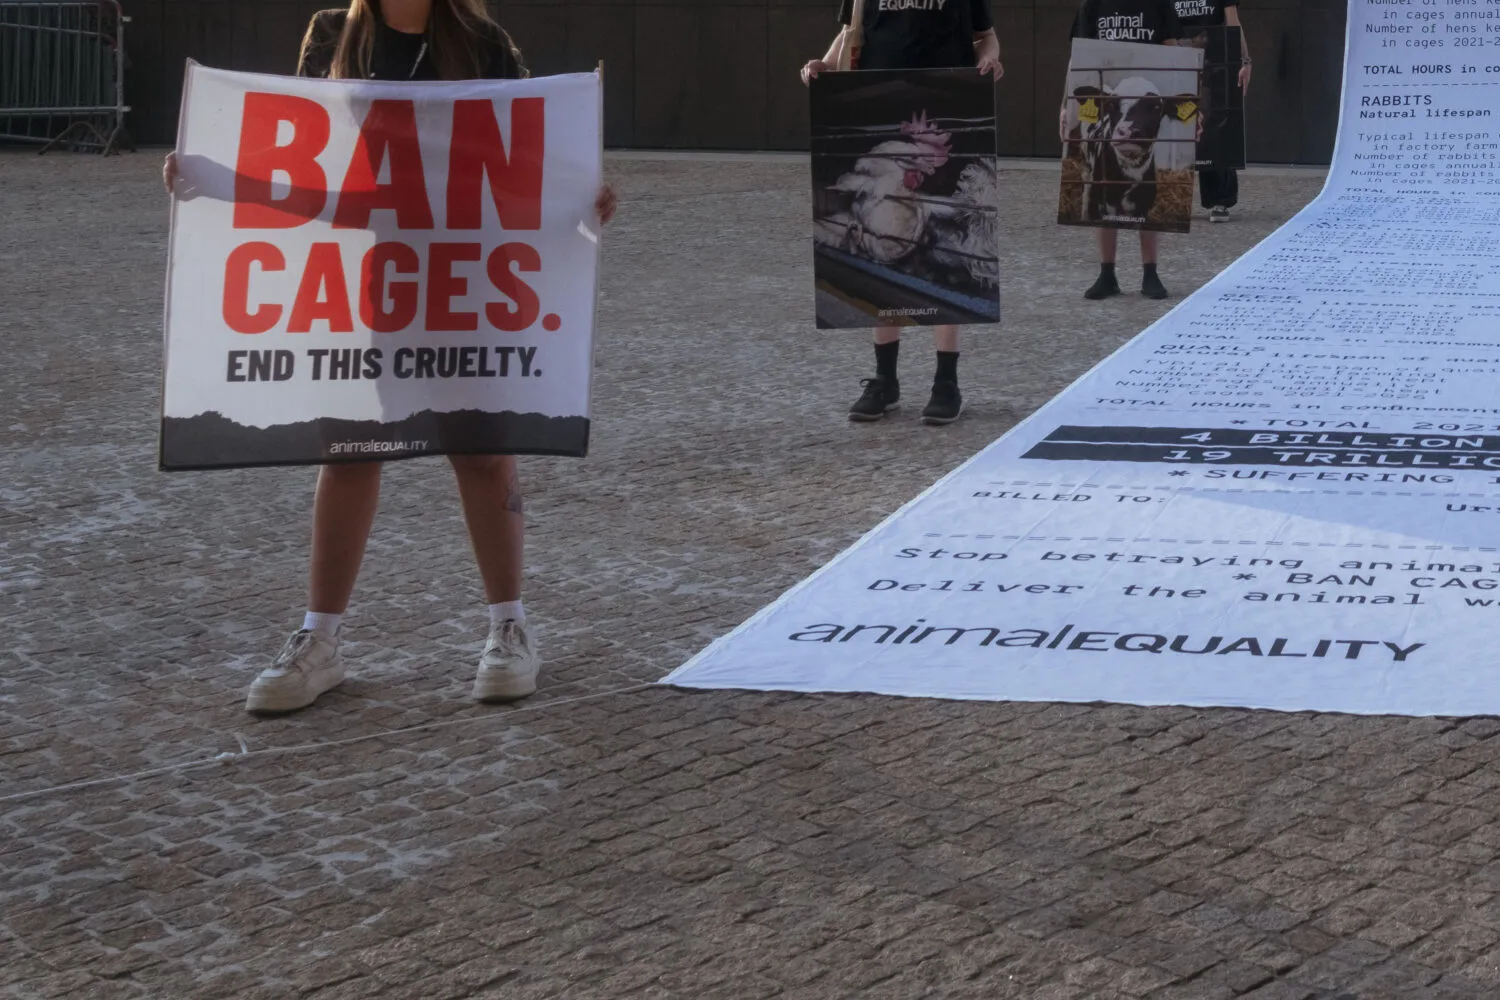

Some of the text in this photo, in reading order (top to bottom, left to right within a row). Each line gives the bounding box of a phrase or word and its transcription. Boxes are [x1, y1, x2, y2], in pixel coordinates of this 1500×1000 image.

[1099, 12, 1143, 28] animal
[1382, 8, 1401, 20] in
[1406, 11, 1445, 22] cages
[1099, 29, 1155, 40] EQUALITY
[1365, 23, 1414, 34] Number
[1421, 23, 1437, 34] of
[1445, 23, 1477, 34] hens
[1381, 39, 1397, 48] in
[1405, 39, 1444, 50] cages
[1363, 64, 1403, 75] TOTAL
[1411, 64, 1452, 74] HOURS
[1460, 62, 1478, 75] in
[1361, 94, 1432, 107] RABBITS
[233, 91, 544, 231] BAN
[222, 241, 562, 334] CAGES.
[226, 347, 543, 382] END THIS CRUELTY.
[1263, 419, 1382, 430] TOTAL
[330, 439, 428, 454] animalEQUALITY
[1181, 432, 1211, 442] 4
[1249, 434, 1483, 447] BILLION
[1163, 451, 1231, 460] 19
[1205, 469, 1454, 484] SUFFERING
[972, 491, 1163, 503] BILLED TO:
[895, 547, 1009, 562] Stop
[1040, 551, 1304, 570] betraying
[1286, 572, 1376, 587] BAN
[866, 579, 1084, 594] Deliver
[1123, 584, 1207, 598] the
[1243, 591, 1425, 605] animal
[788, 618, 1426, 662] animalEQUALITY
